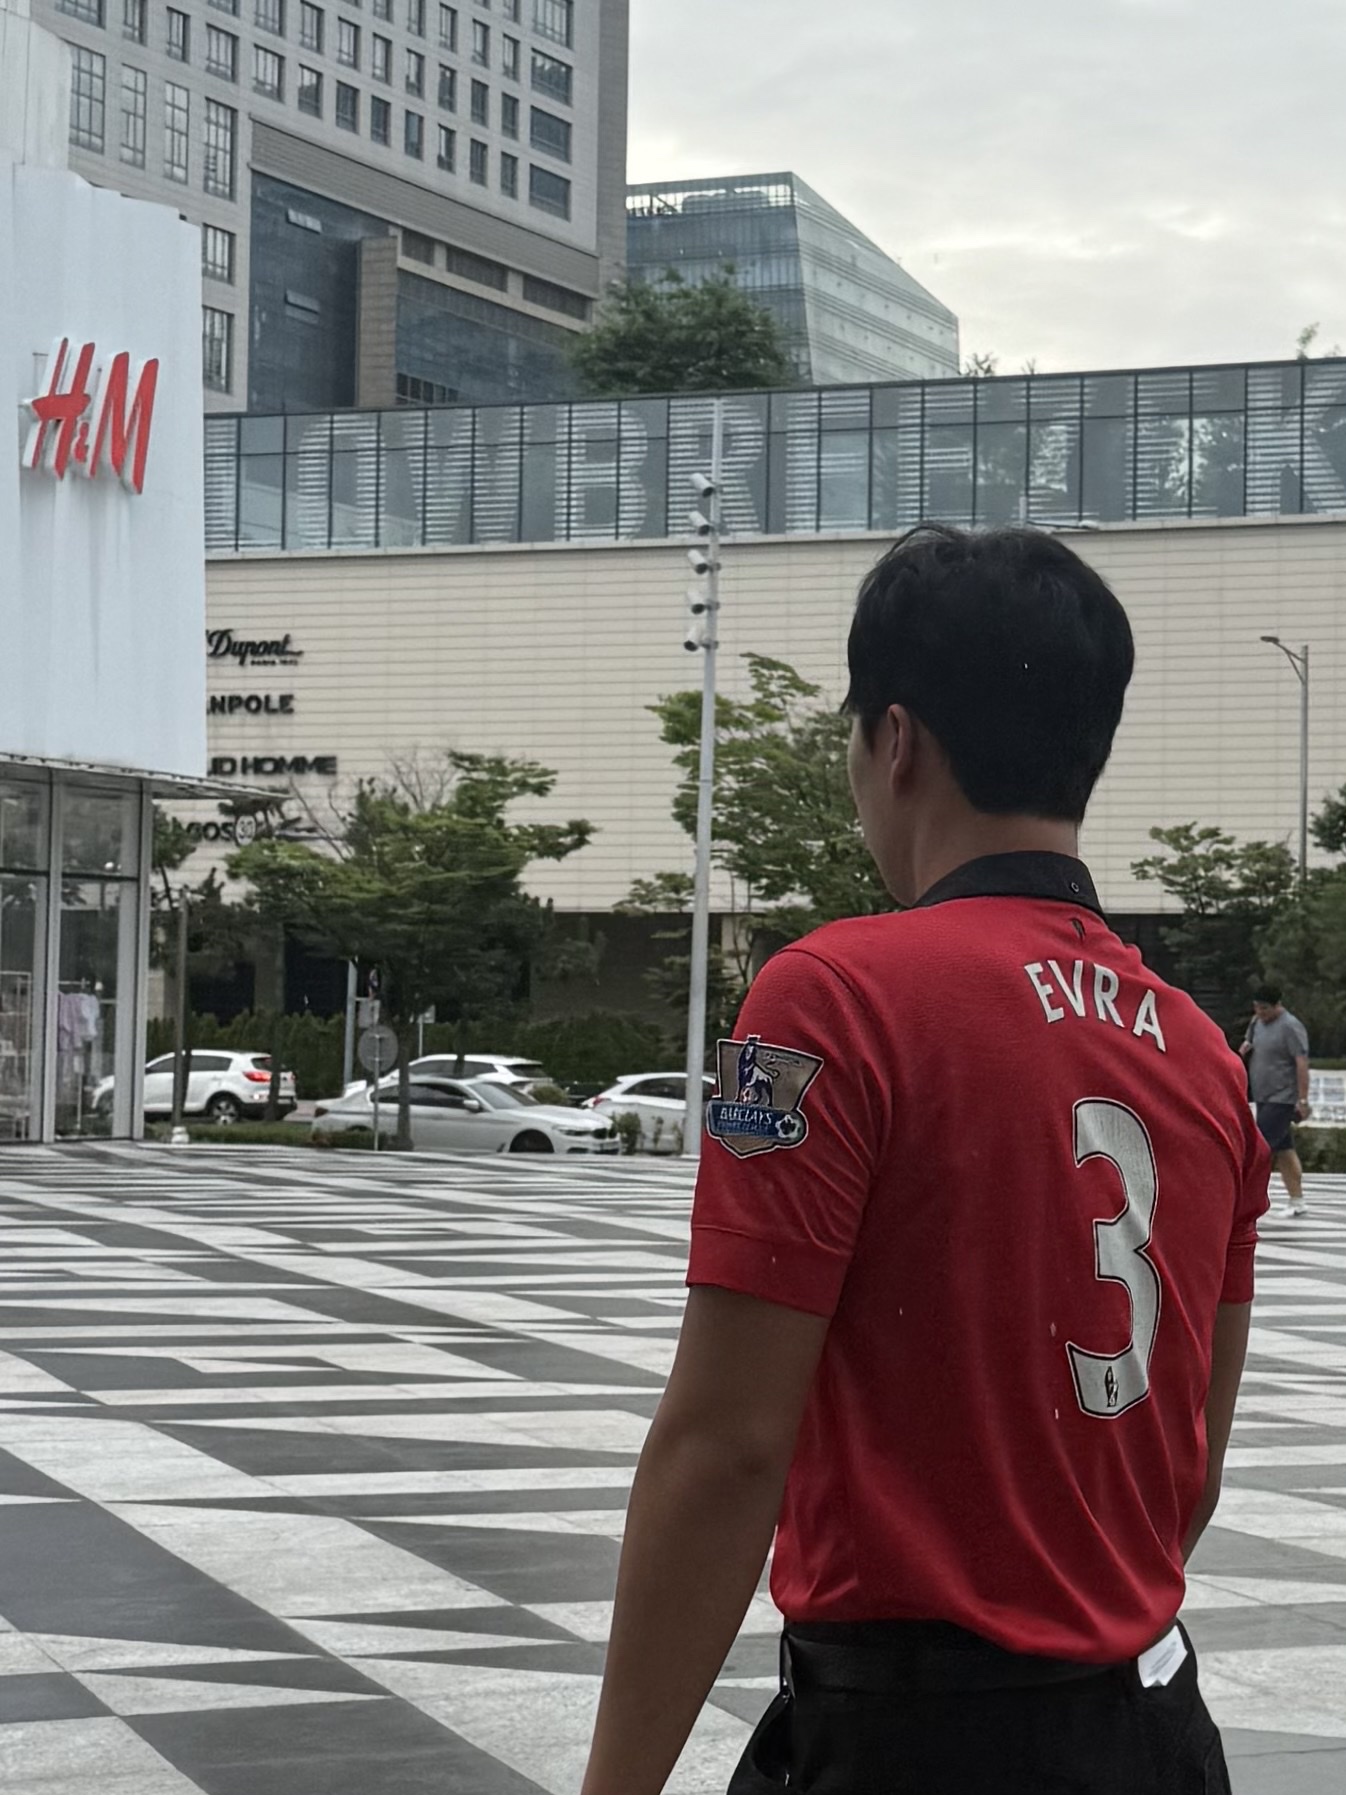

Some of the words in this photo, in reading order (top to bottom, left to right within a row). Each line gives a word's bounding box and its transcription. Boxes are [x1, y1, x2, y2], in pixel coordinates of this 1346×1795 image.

[27, 336, 160, 496] H&M
[206, 629, 304, 666] Dupont
[206, 694, 294, 716] NPOLE
[241, 756, 337, 777] HOMME
[1023, 958, 1167, 1053] EVRA
[1066, 1097, 1162, 1420] 3
